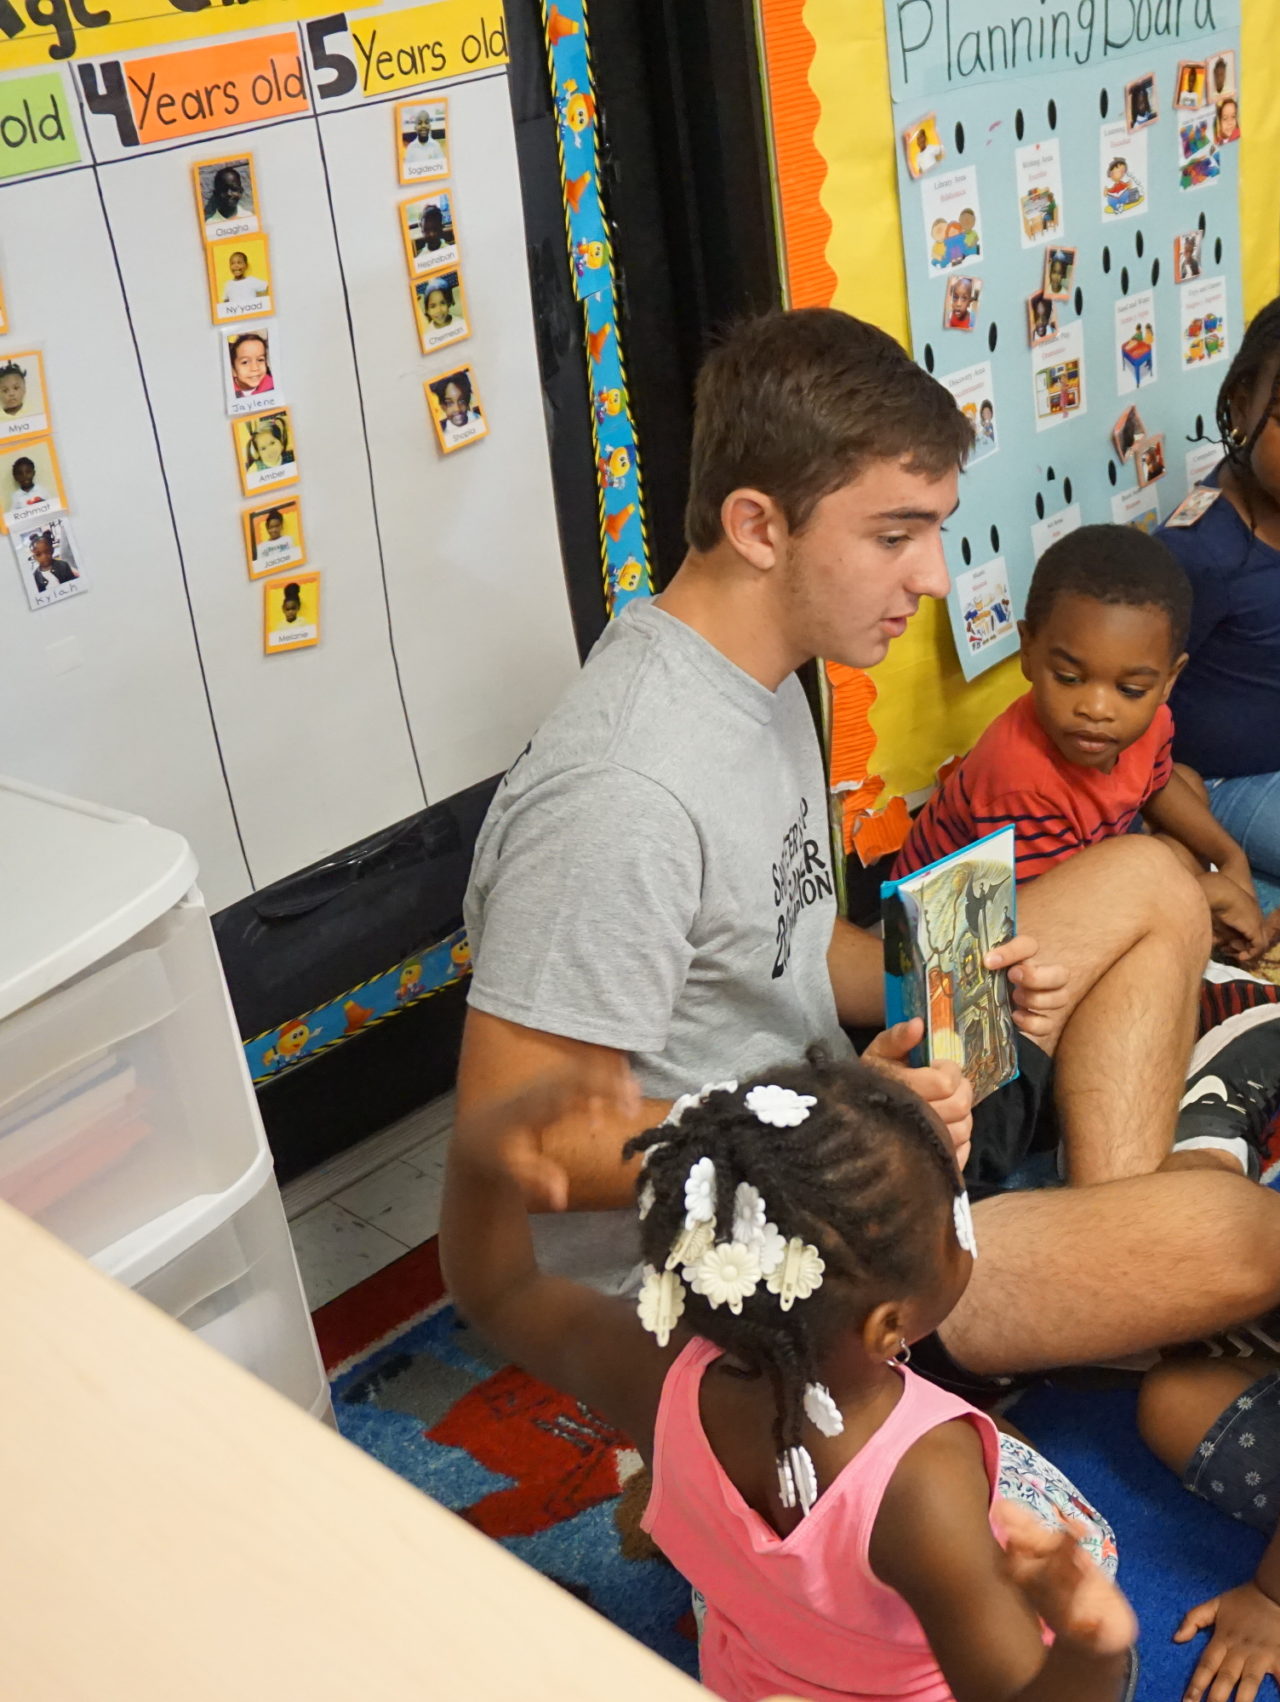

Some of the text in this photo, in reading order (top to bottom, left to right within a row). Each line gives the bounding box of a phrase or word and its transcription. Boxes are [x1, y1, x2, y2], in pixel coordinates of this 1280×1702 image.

[306, 12, 508, 99] 5 Years old
[897, 0, 1094, 84] Planning
[1, 94, 66, 148] old
[77, 56, 308, 146] 4 Years old
[8, 422, 30, 434] Mya
[13, 503, 52, 521] Rahmat
